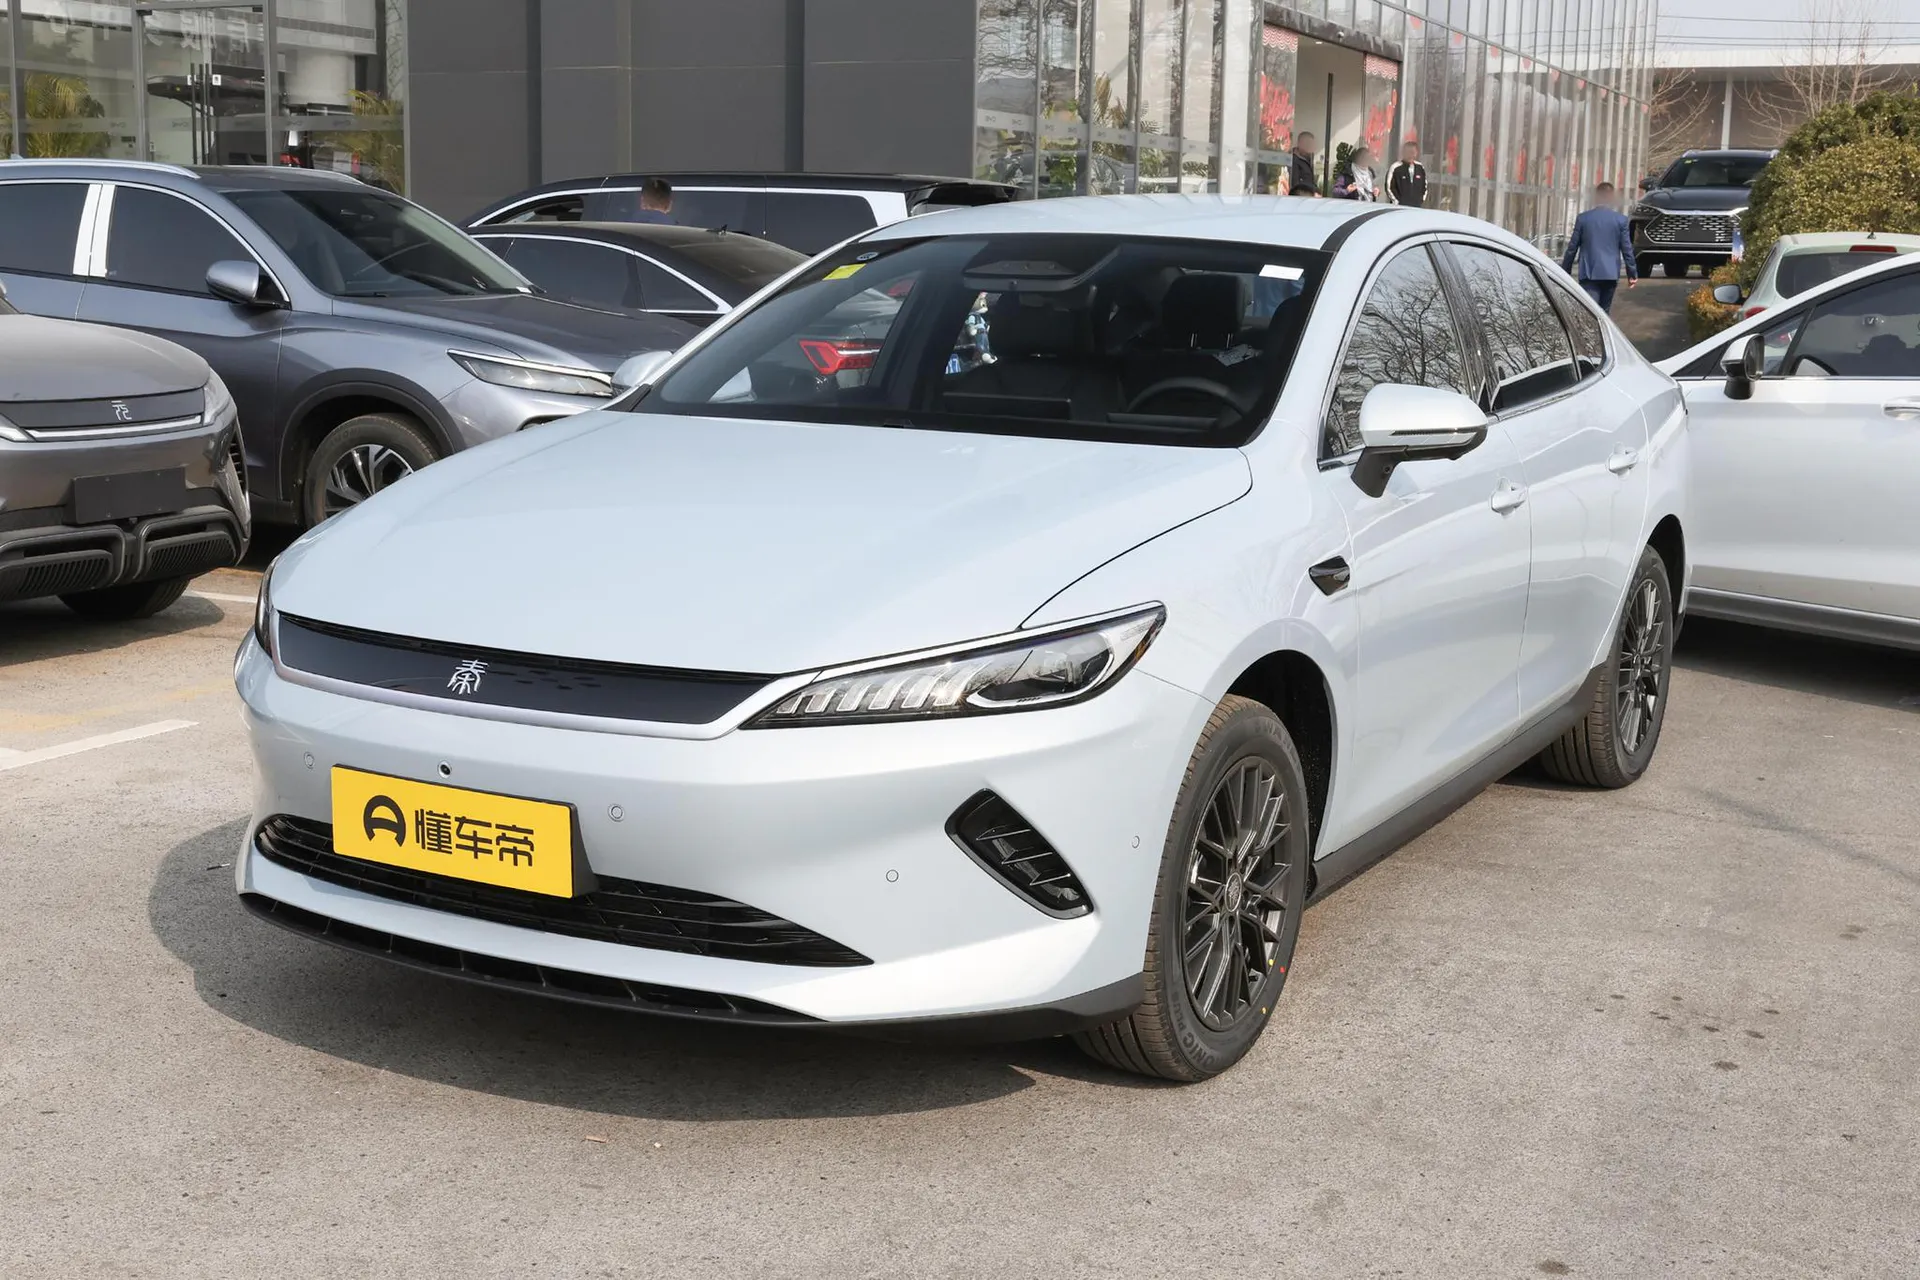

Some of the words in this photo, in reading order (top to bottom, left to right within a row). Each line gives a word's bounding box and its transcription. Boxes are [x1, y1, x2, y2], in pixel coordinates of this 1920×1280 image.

[447, 659, 488, 695] 秦
[414, 808, 535, 867] 懂车帝
